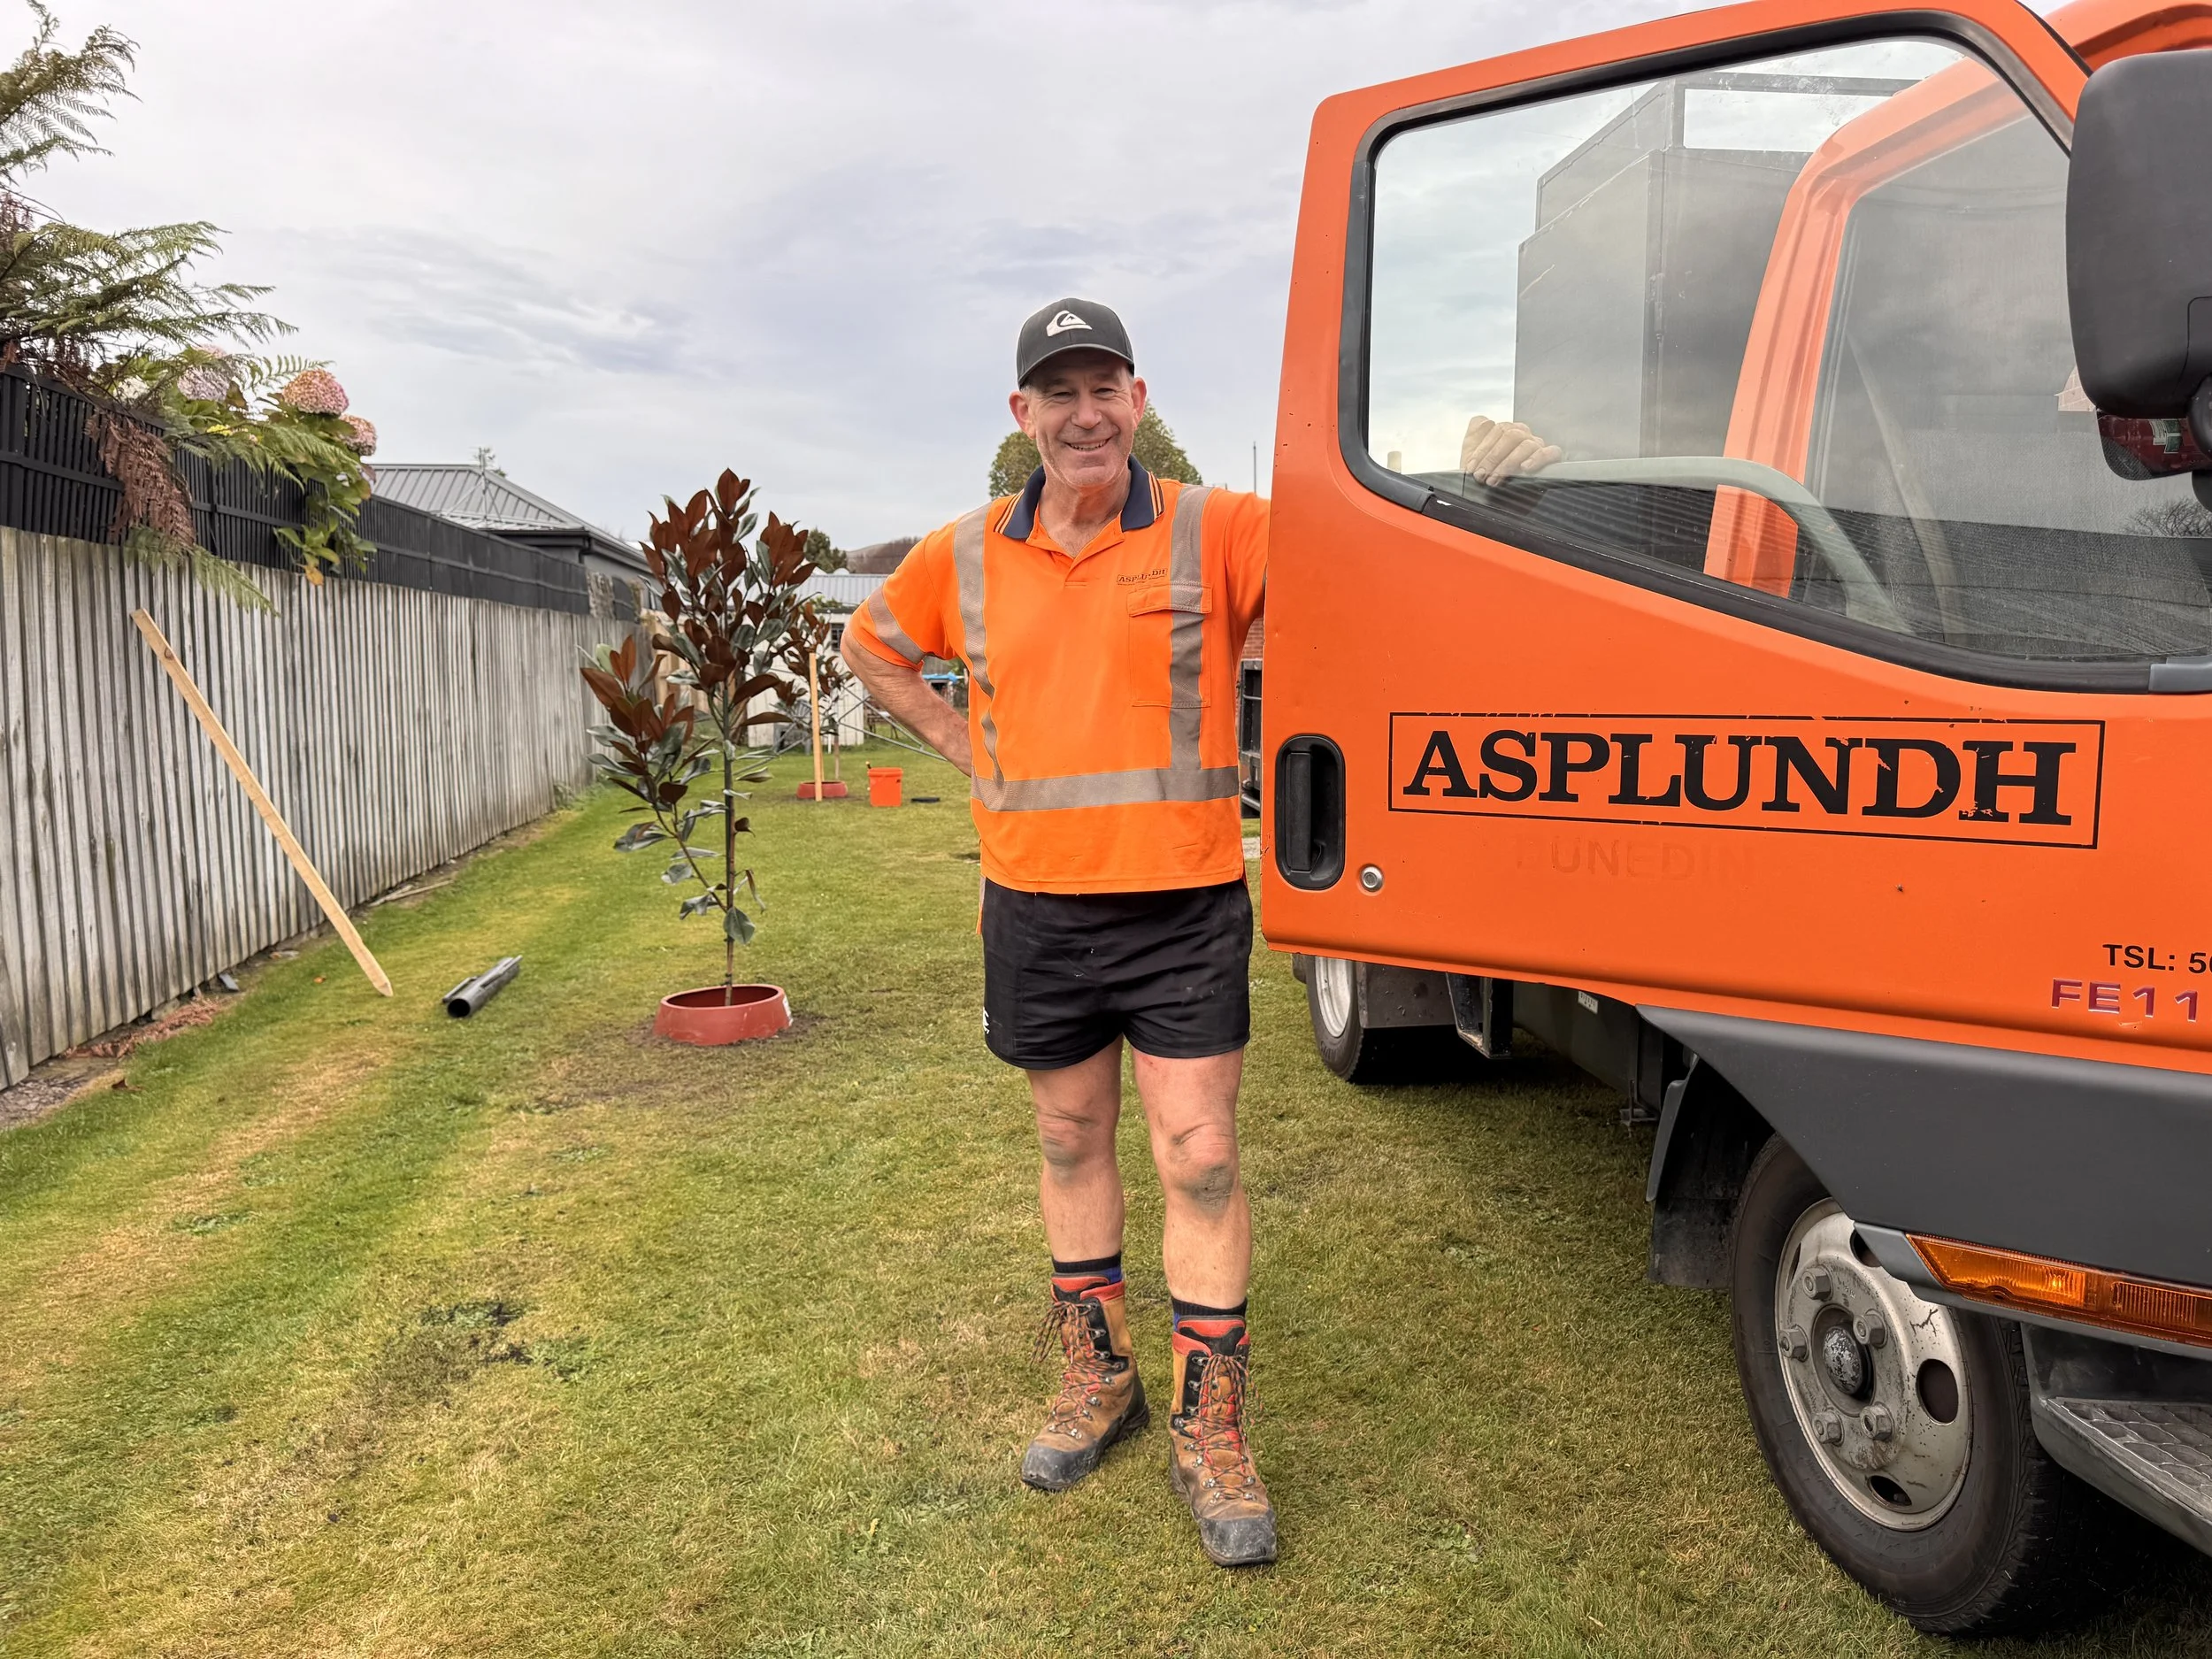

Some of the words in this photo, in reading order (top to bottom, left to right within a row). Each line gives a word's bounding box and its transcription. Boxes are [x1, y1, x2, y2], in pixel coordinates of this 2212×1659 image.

[1402, 729, 2078, 826] ASPLUNDH
[2102, 943, 2175, 972] TSL:
[2188, 951, 2212, 974] 5
